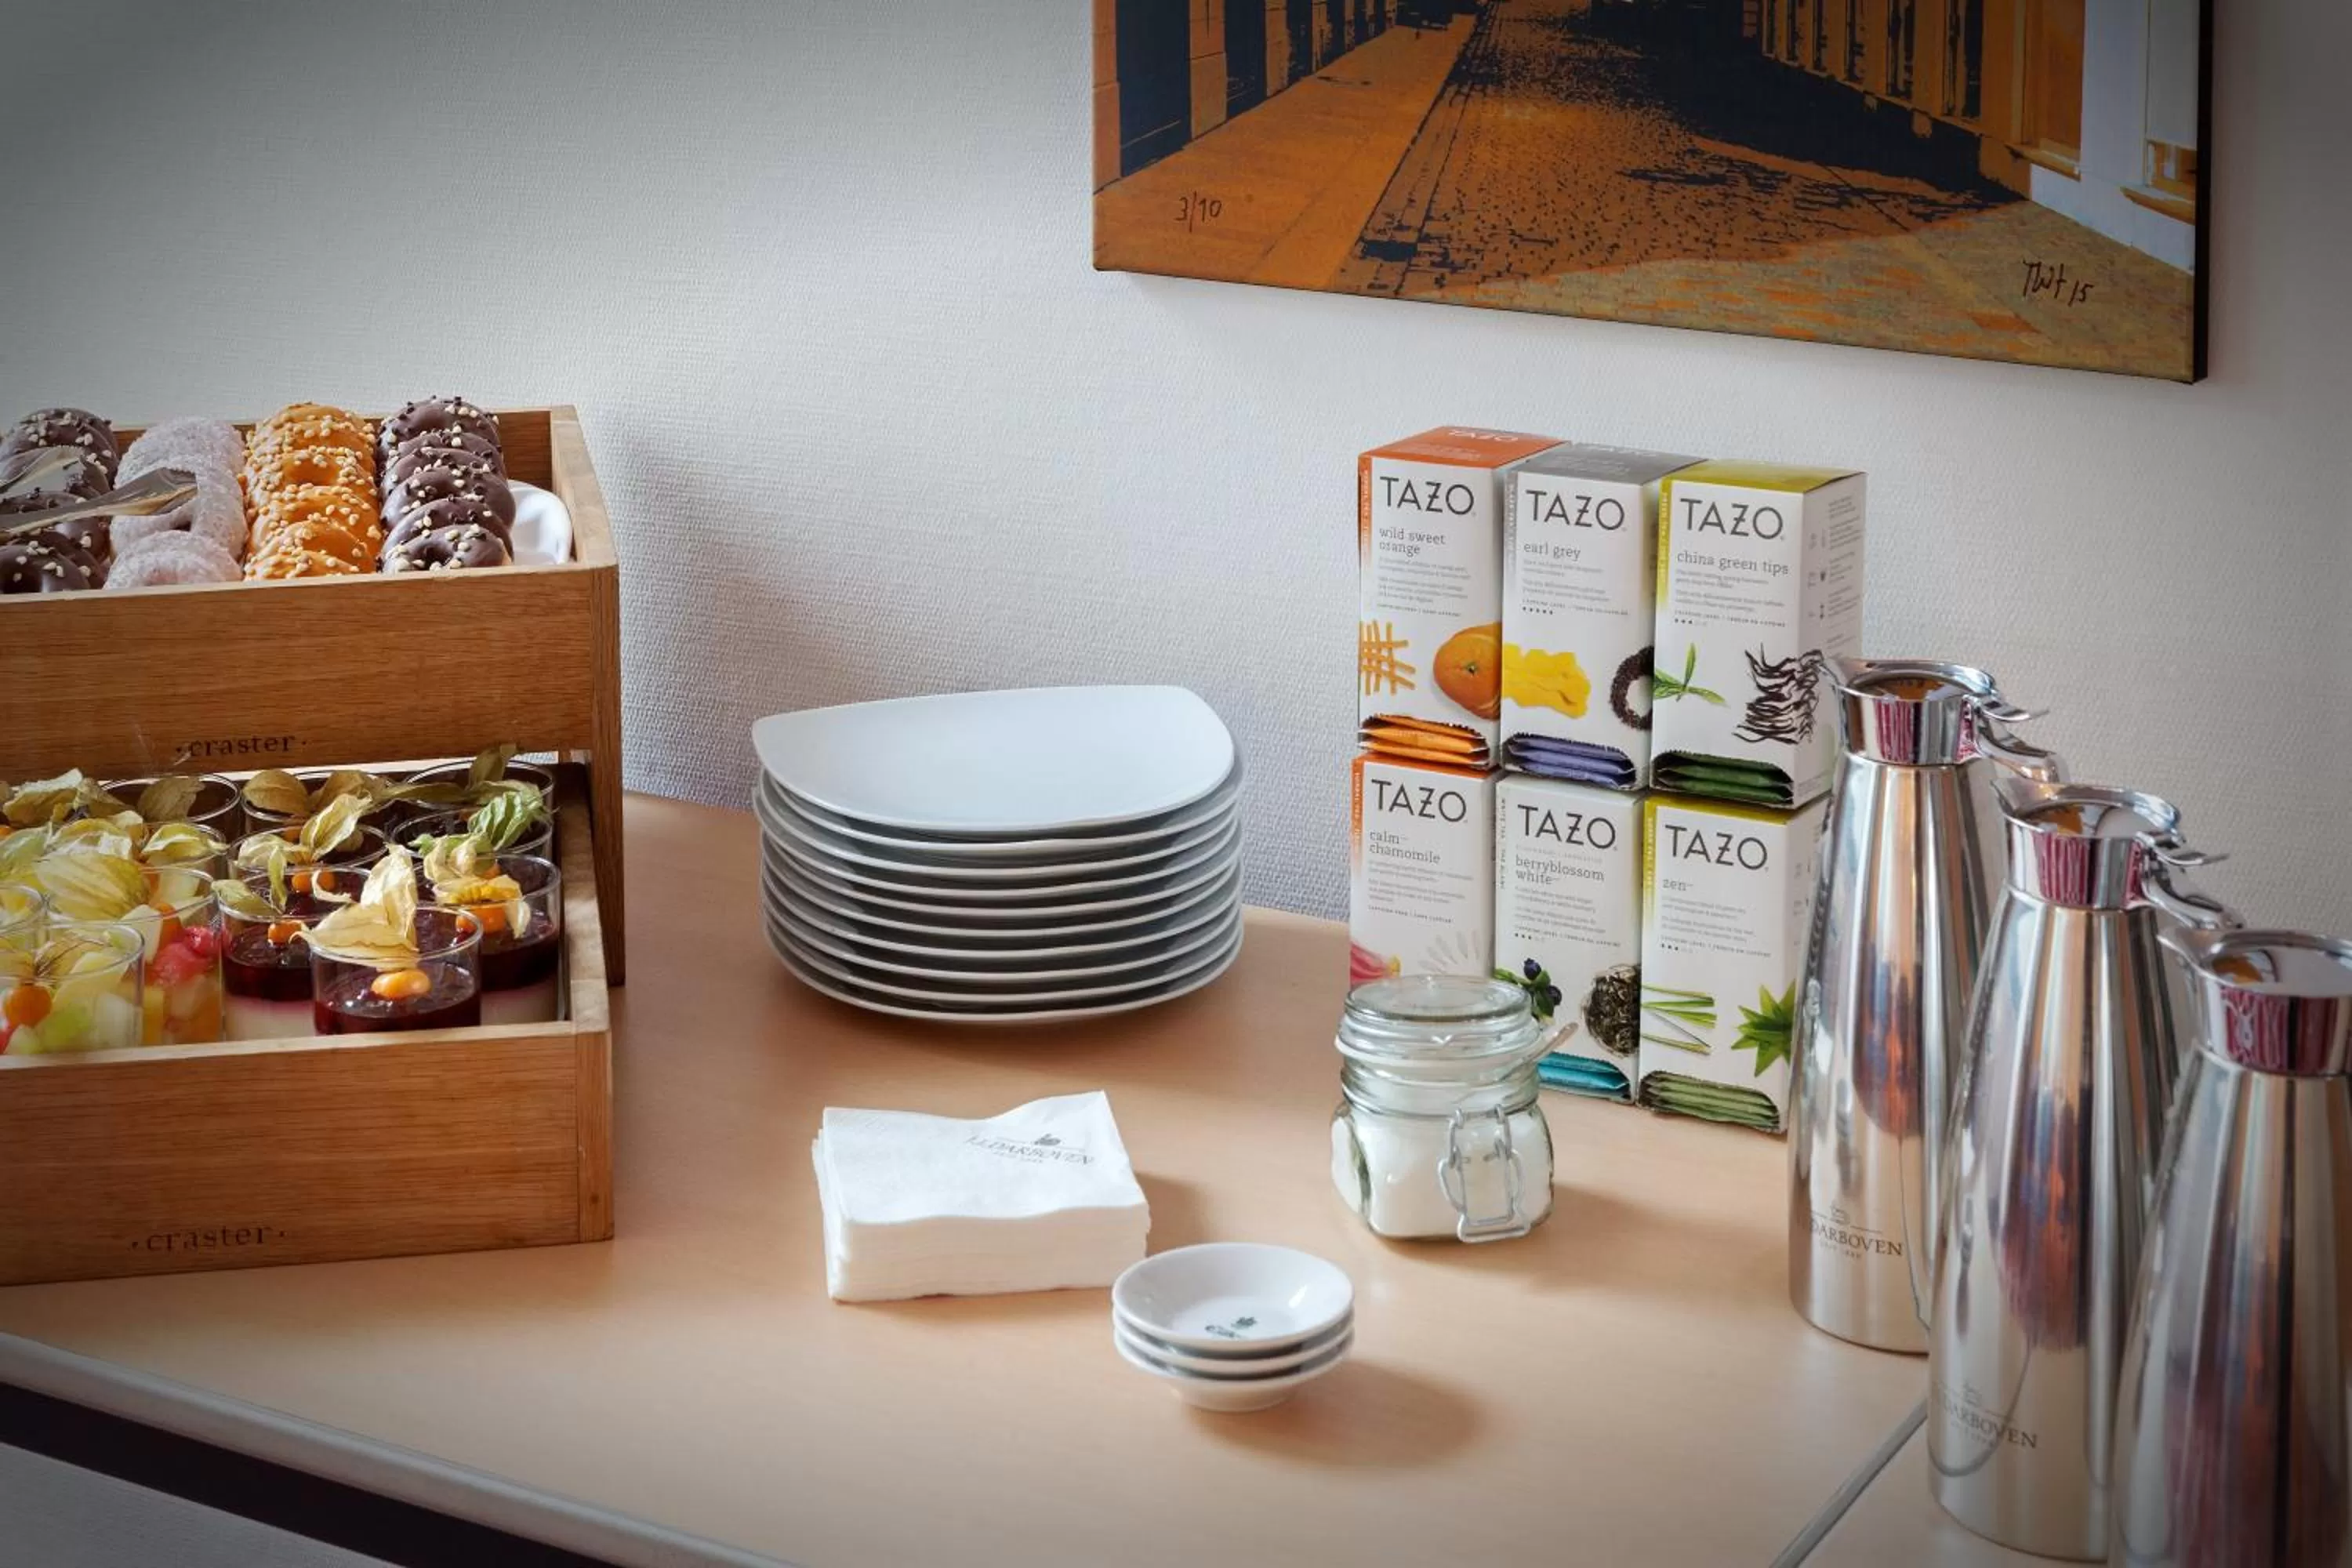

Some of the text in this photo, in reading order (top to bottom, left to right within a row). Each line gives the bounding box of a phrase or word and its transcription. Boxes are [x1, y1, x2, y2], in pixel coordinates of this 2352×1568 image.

[1173, 190, 1222, 234] 3/10
[1379, 476, 1474, 515] TAZO
[1526, 490, 1624, 531] TAZO
[1379, 526, 1404, 540] wild
[1408, 532, 1446, 545] sweet
[1680, 498, 1783, 539] TAZO
[1379, 542, 1421, 557] orange
[1523, 542, 1581, 561] earl grey
[1677, 550, 1715, 565] china
[1719, 557, 1758, 571] green
[1762, 561, 1789, 577] tips
[1371, 779, 1466, 822] TAZO
[1517, 804, 1616, 848] TAZO
[1369, 842, 1441, 863] chamomile
[1665, 825, 1767, 870] TAZO
[1515, 855, 1605, 882] berryblossom
